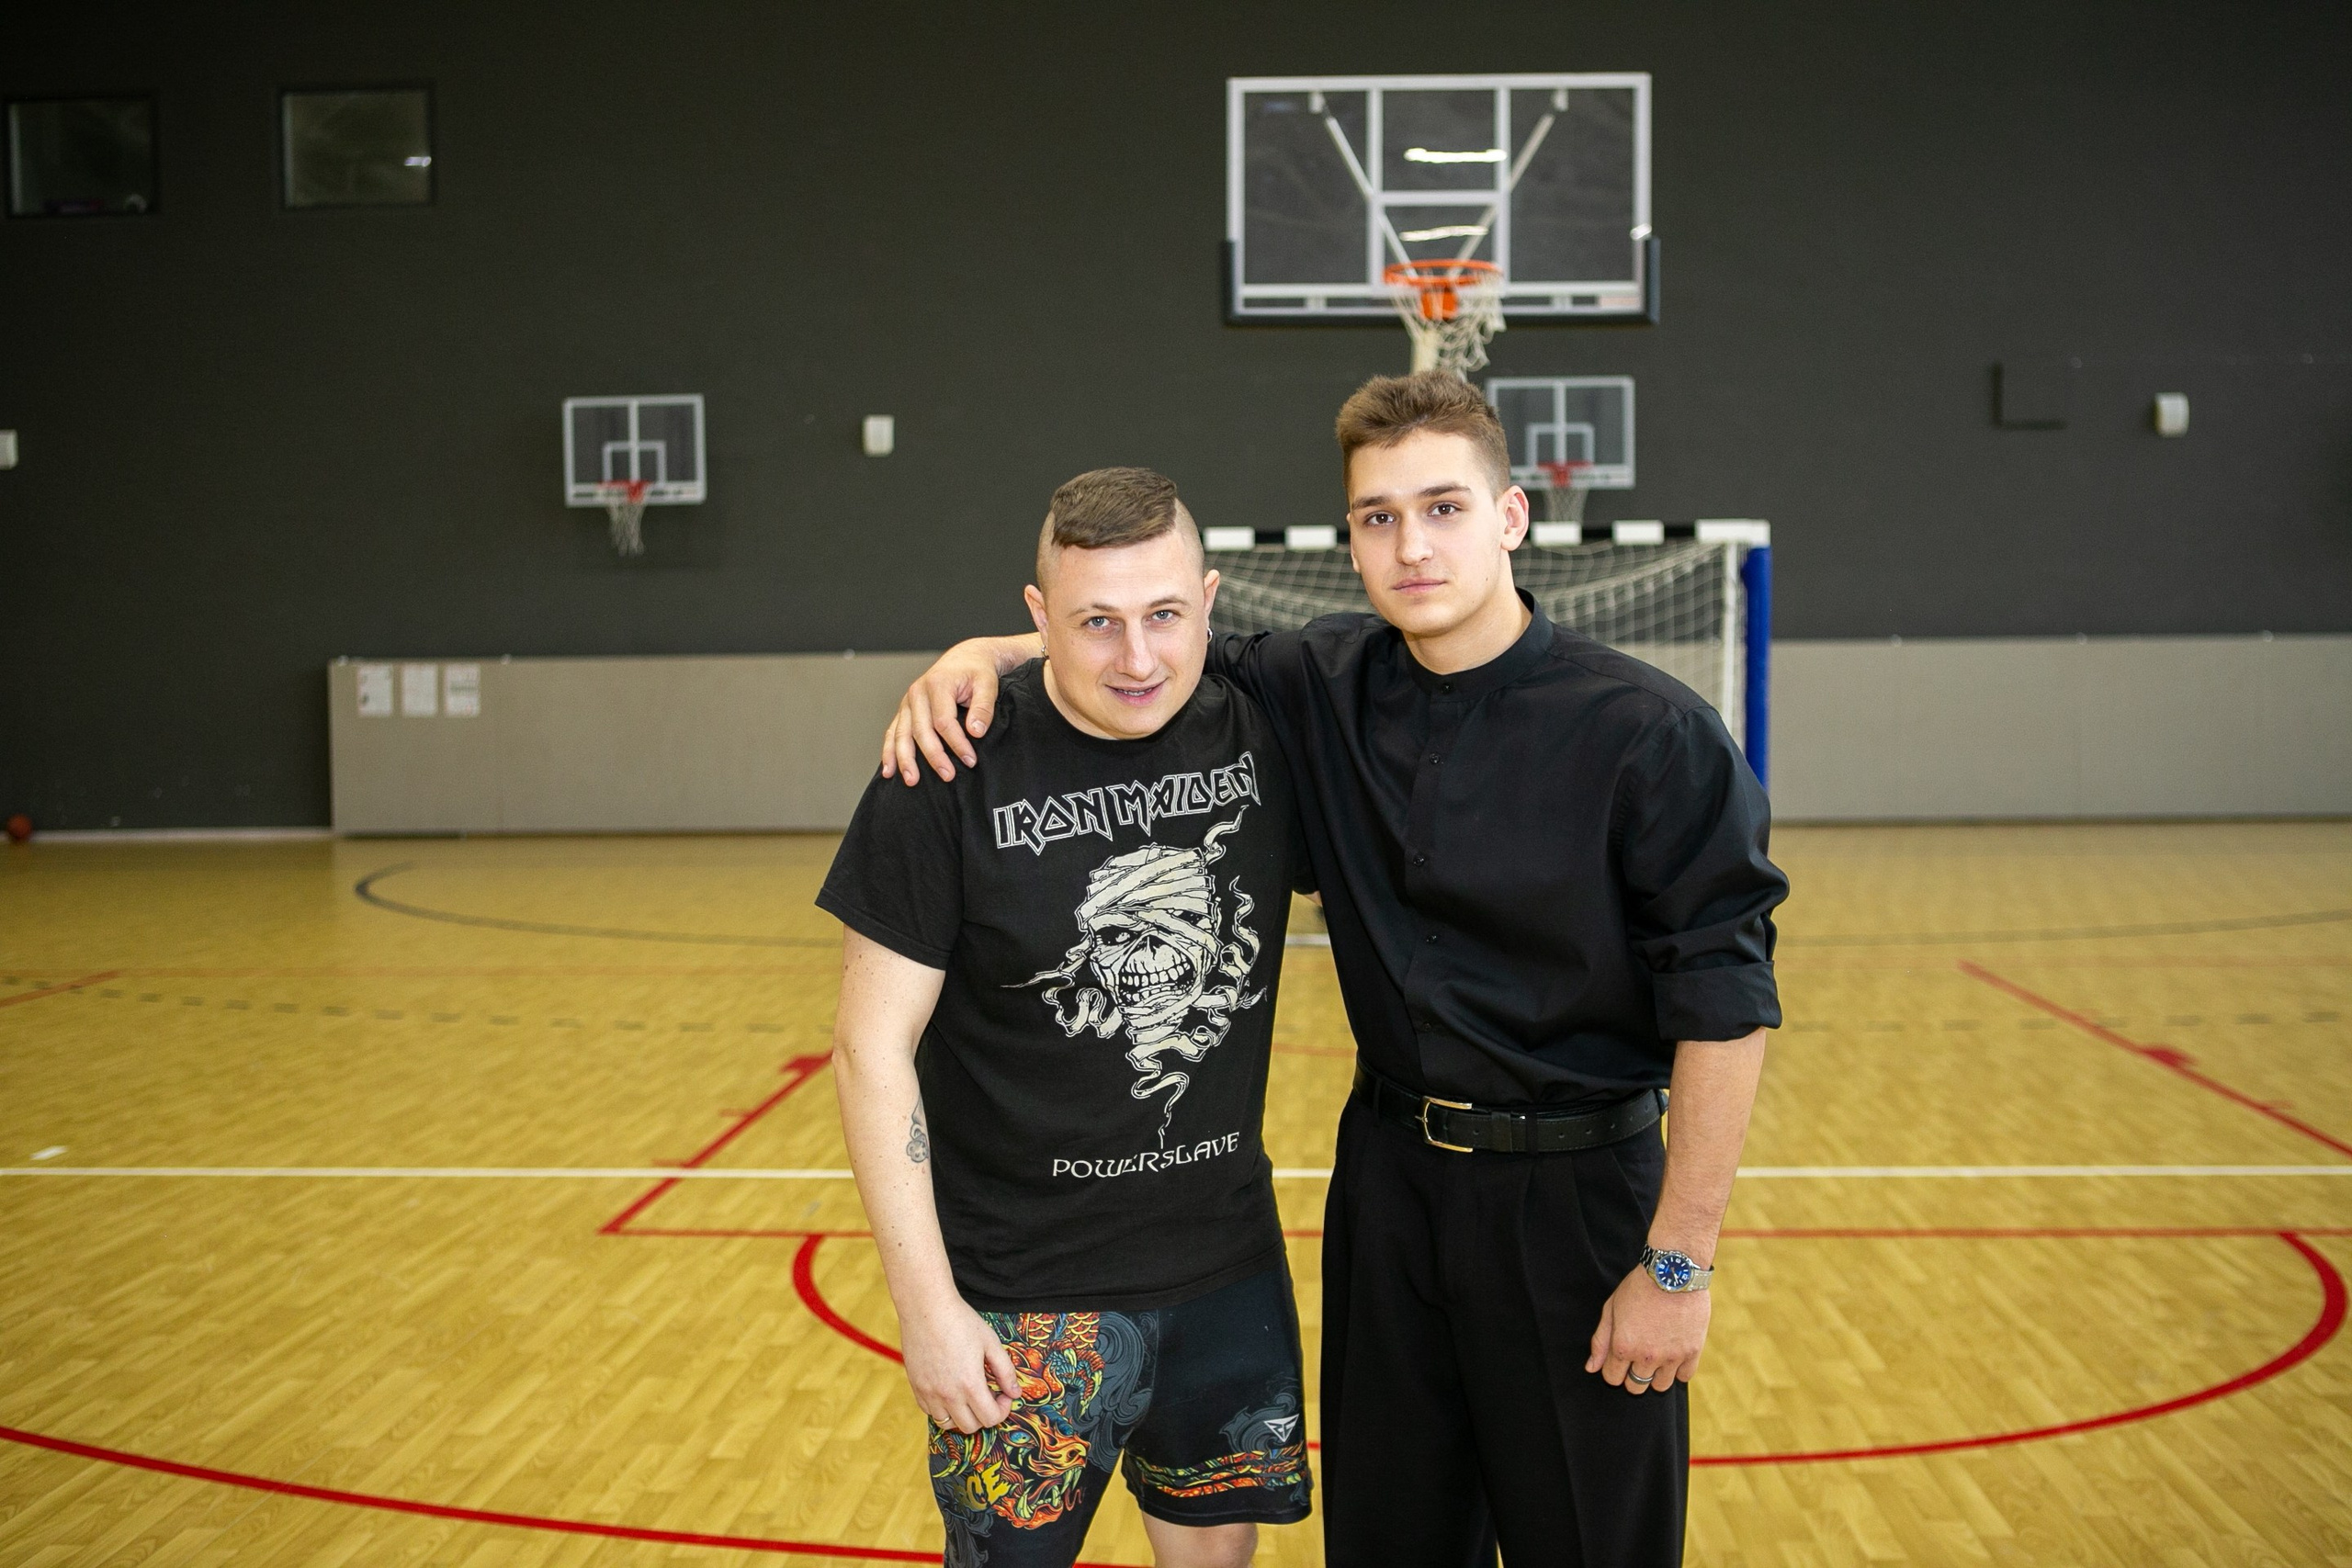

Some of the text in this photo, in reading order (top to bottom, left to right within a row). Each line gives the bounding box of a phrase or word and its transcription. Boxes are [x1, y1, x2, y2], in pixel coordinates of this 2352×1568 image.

[993, 751, 1261, 855] IRON MAIDEN
[1052, 1132, 1240, 1179] POWERSLAVE
